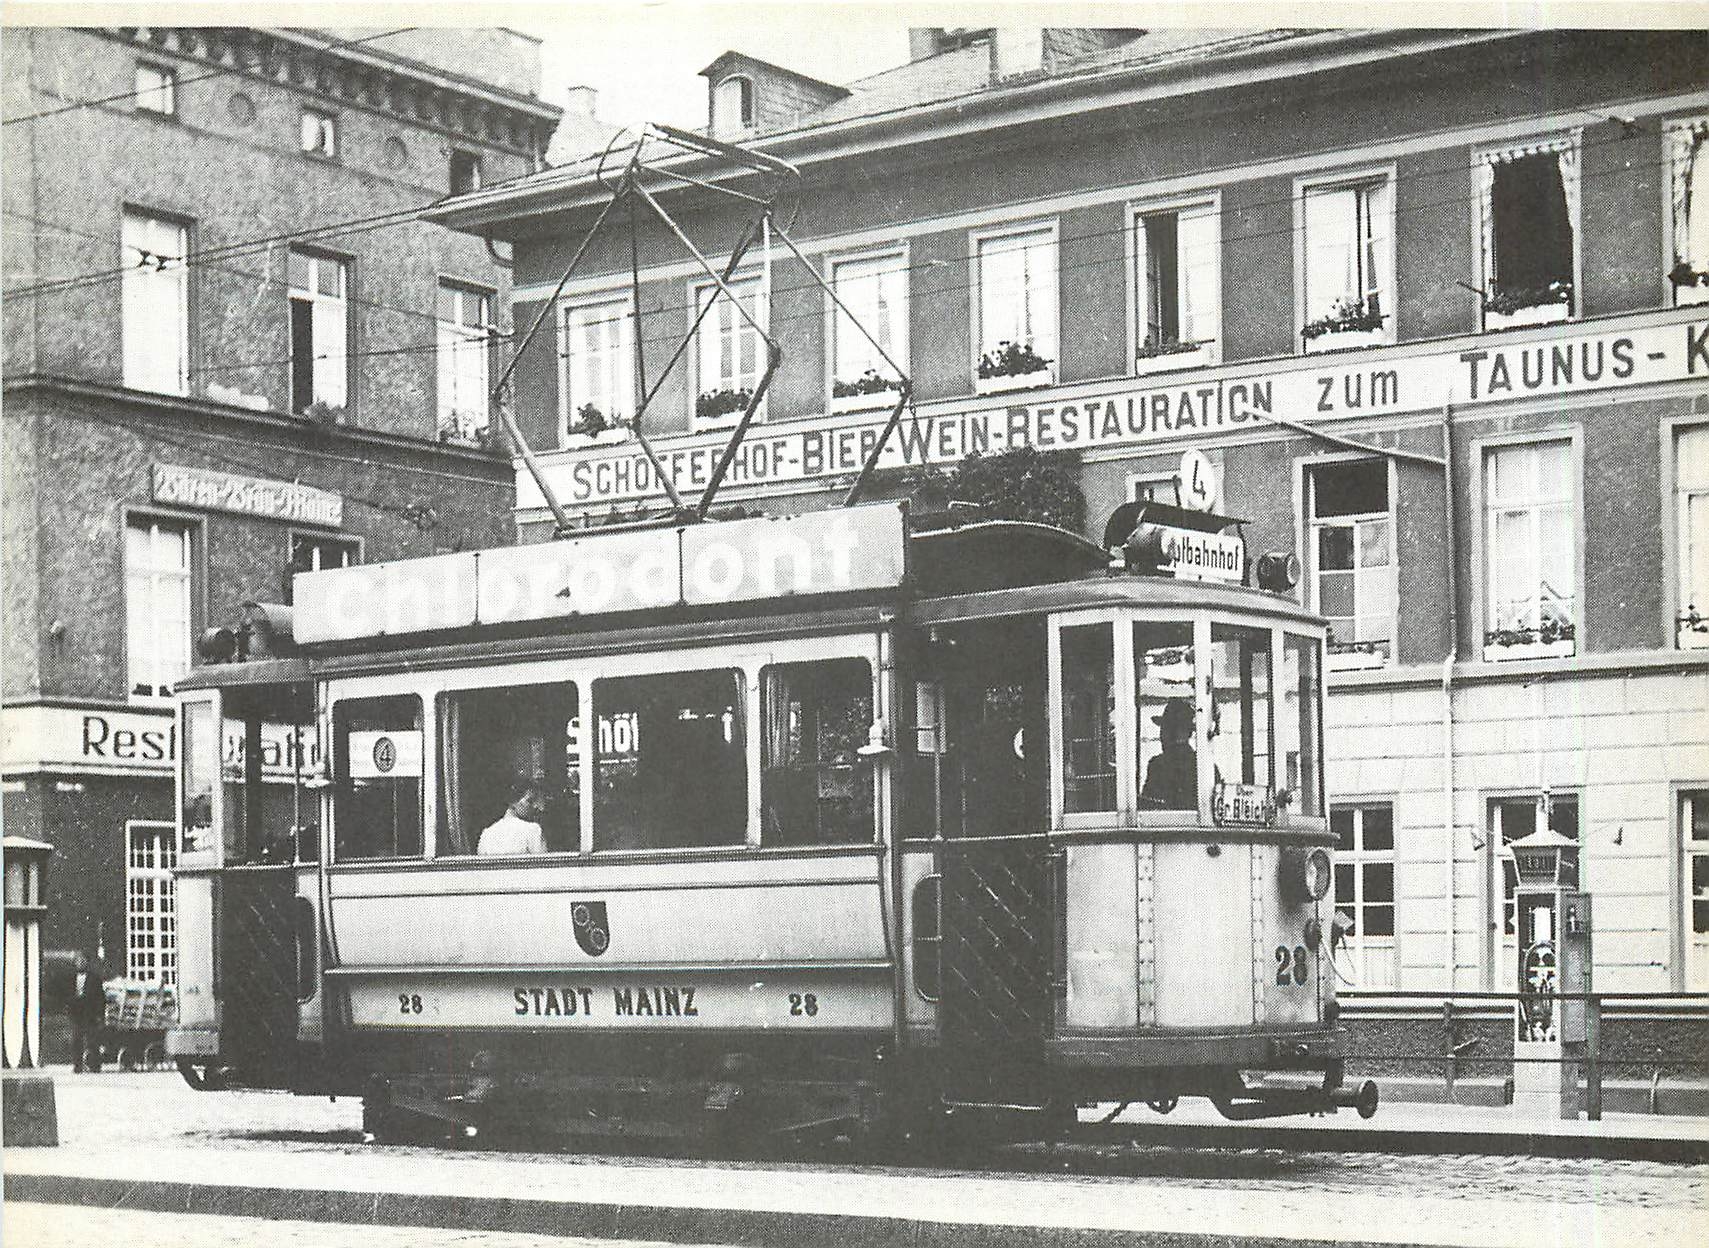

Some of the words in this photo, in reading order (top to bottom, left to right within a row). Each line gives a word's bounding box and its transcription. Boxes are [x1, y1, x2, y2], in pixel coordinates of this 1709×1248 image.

[1317, 369, 1398, 412] zum
[1192, 459, 1206, 501] 4
[1275, 945, 1308, 986] 28
[398, 994, 423, 1014] 28
[514, 988, 592, 1016] STADT
[613, 988, 698, 1016] MAINZ
[788, 992, 818, 1017] 28
